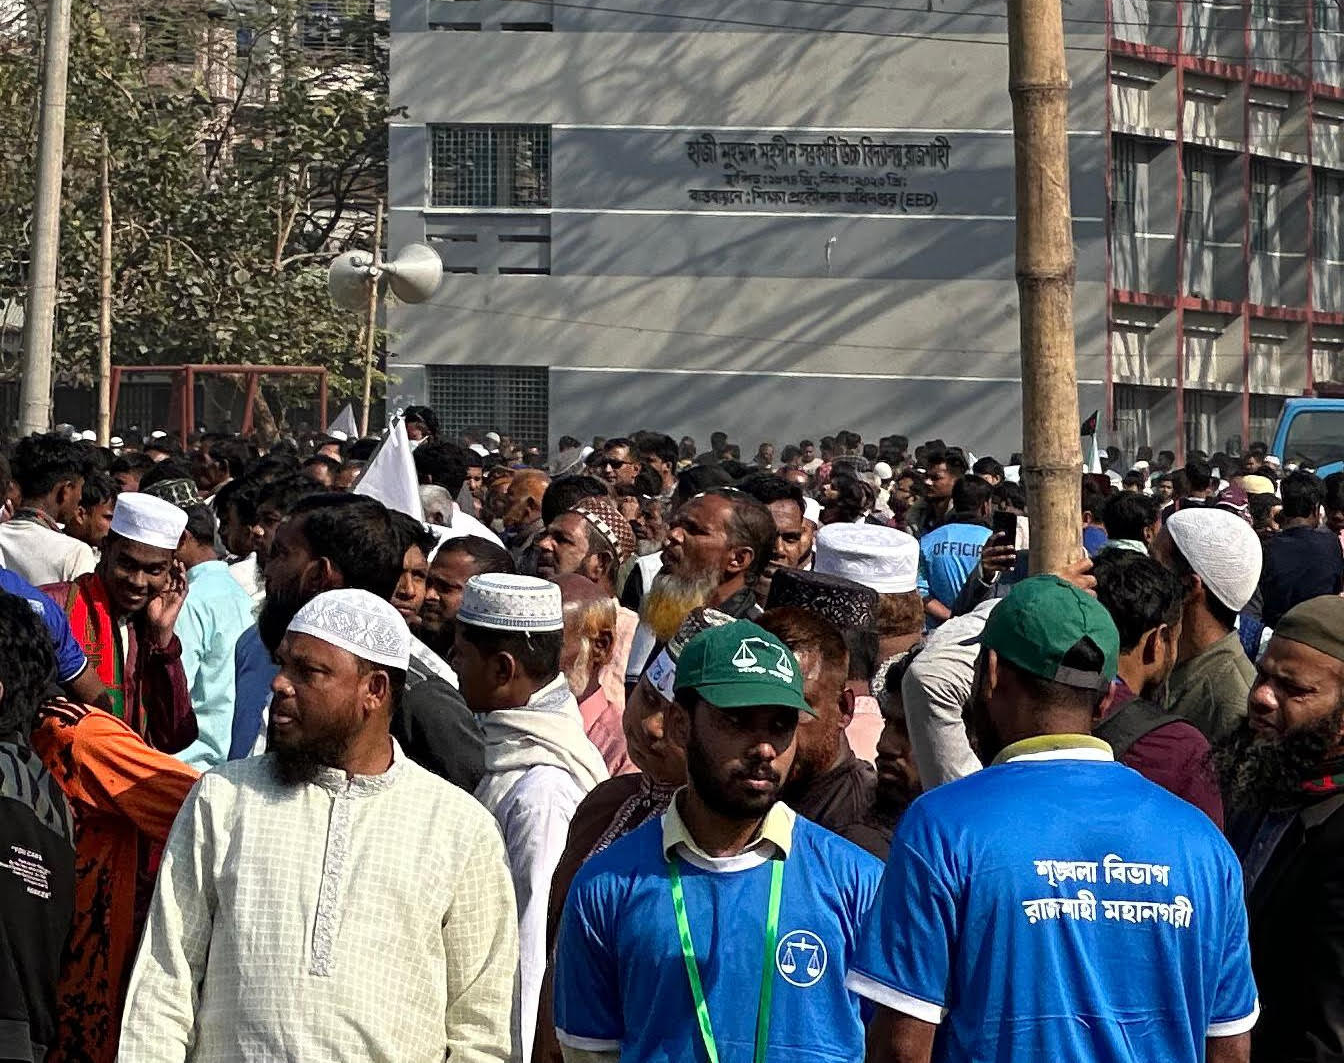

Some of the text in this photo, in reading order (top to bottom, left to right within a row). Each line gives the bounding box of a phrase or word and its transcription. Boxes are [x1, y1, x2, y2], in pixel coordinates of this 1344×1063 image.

[933, 541, 983, 557] OFFICIA
[1033, 853, 1170, 888] শৃঙ্খলা বিভাগ
[1022, 889, 1194, 928] রাজশাহী মহানগরী
